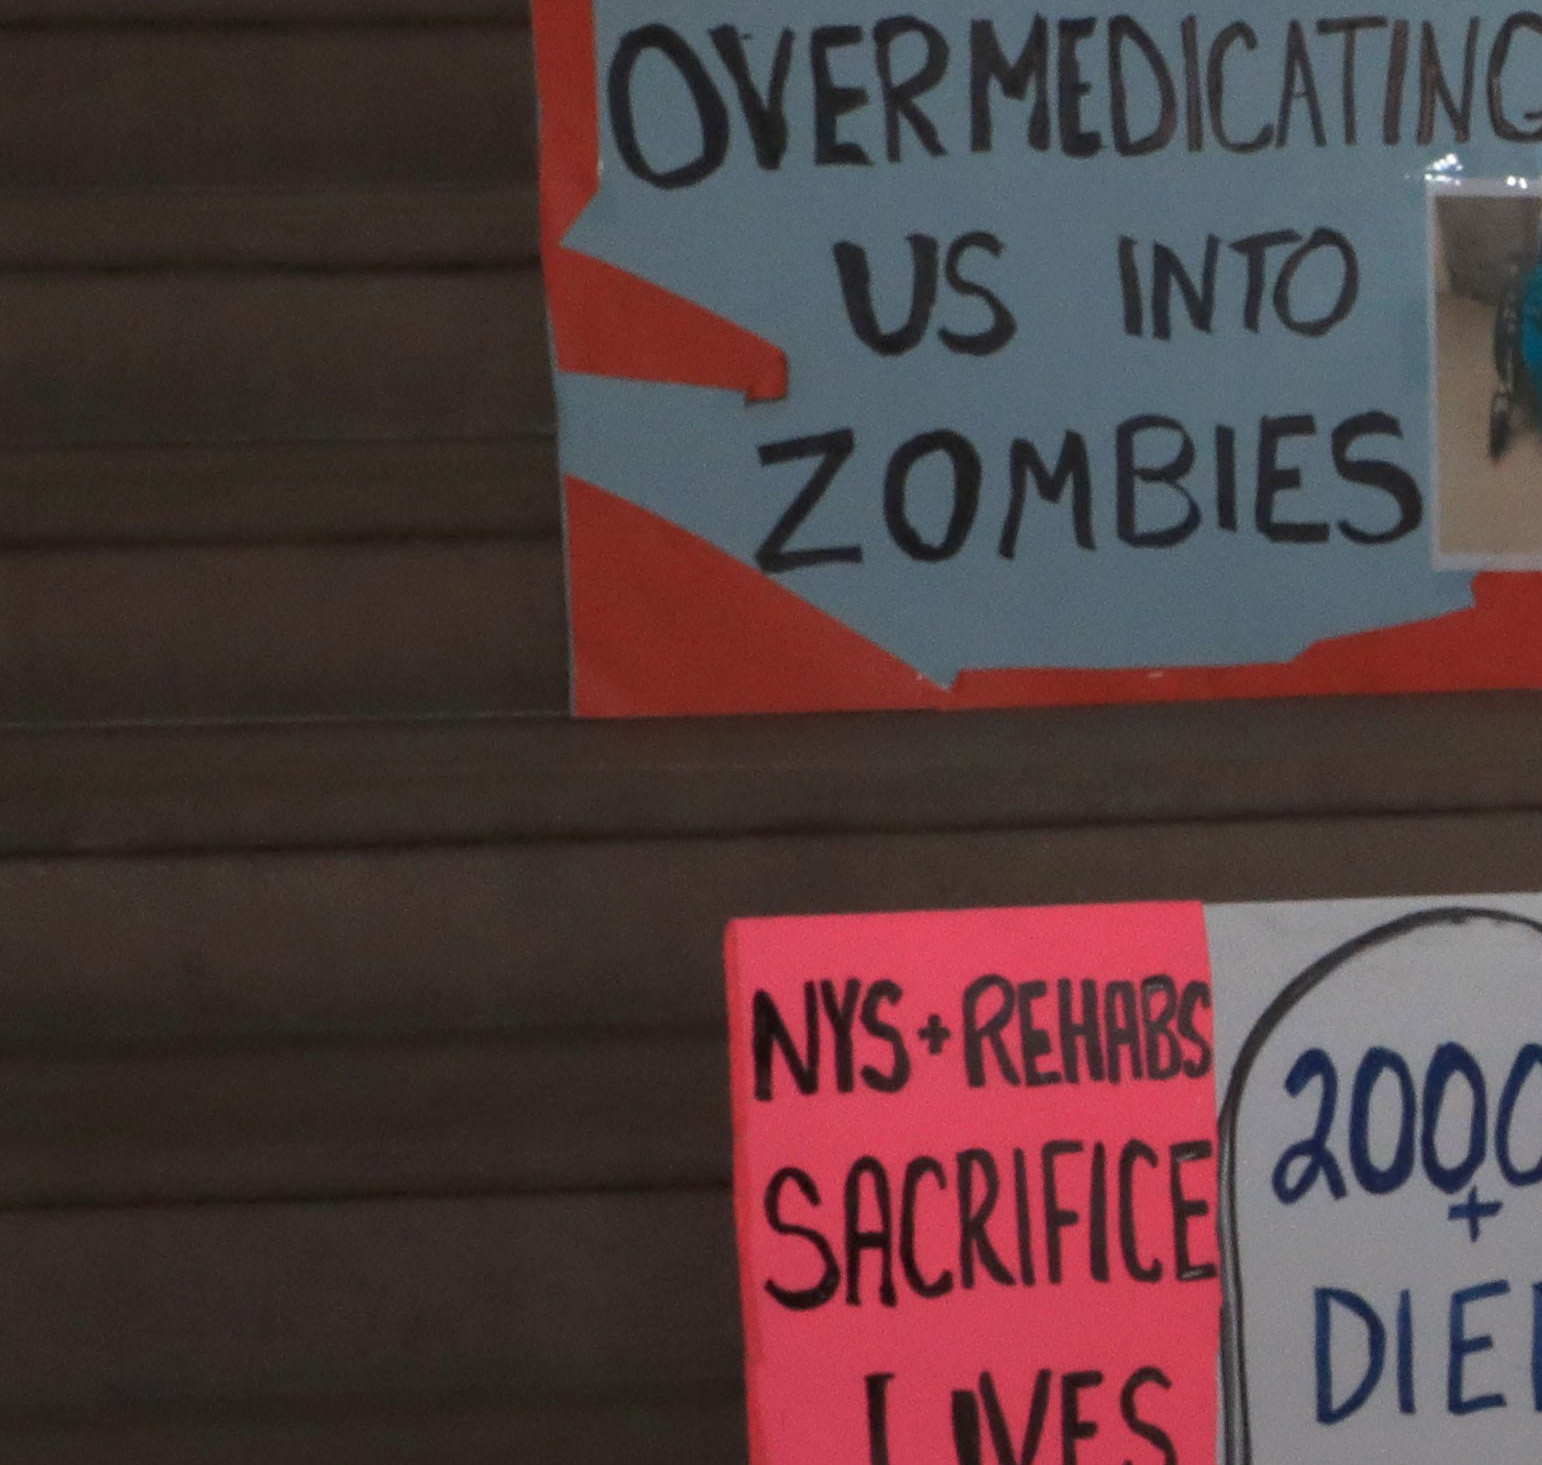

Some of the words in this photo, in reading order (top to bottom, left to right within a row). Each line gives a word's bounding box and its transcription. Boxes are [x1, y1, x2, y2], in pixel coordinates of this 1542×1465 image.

[834, 232, 1017, 356] US
[1119, 227, 1360, 340] INTO
[756, 412, 1424, 572] ZOMBIES
[764, 1138, 1219, 1311] SACRIFICE
